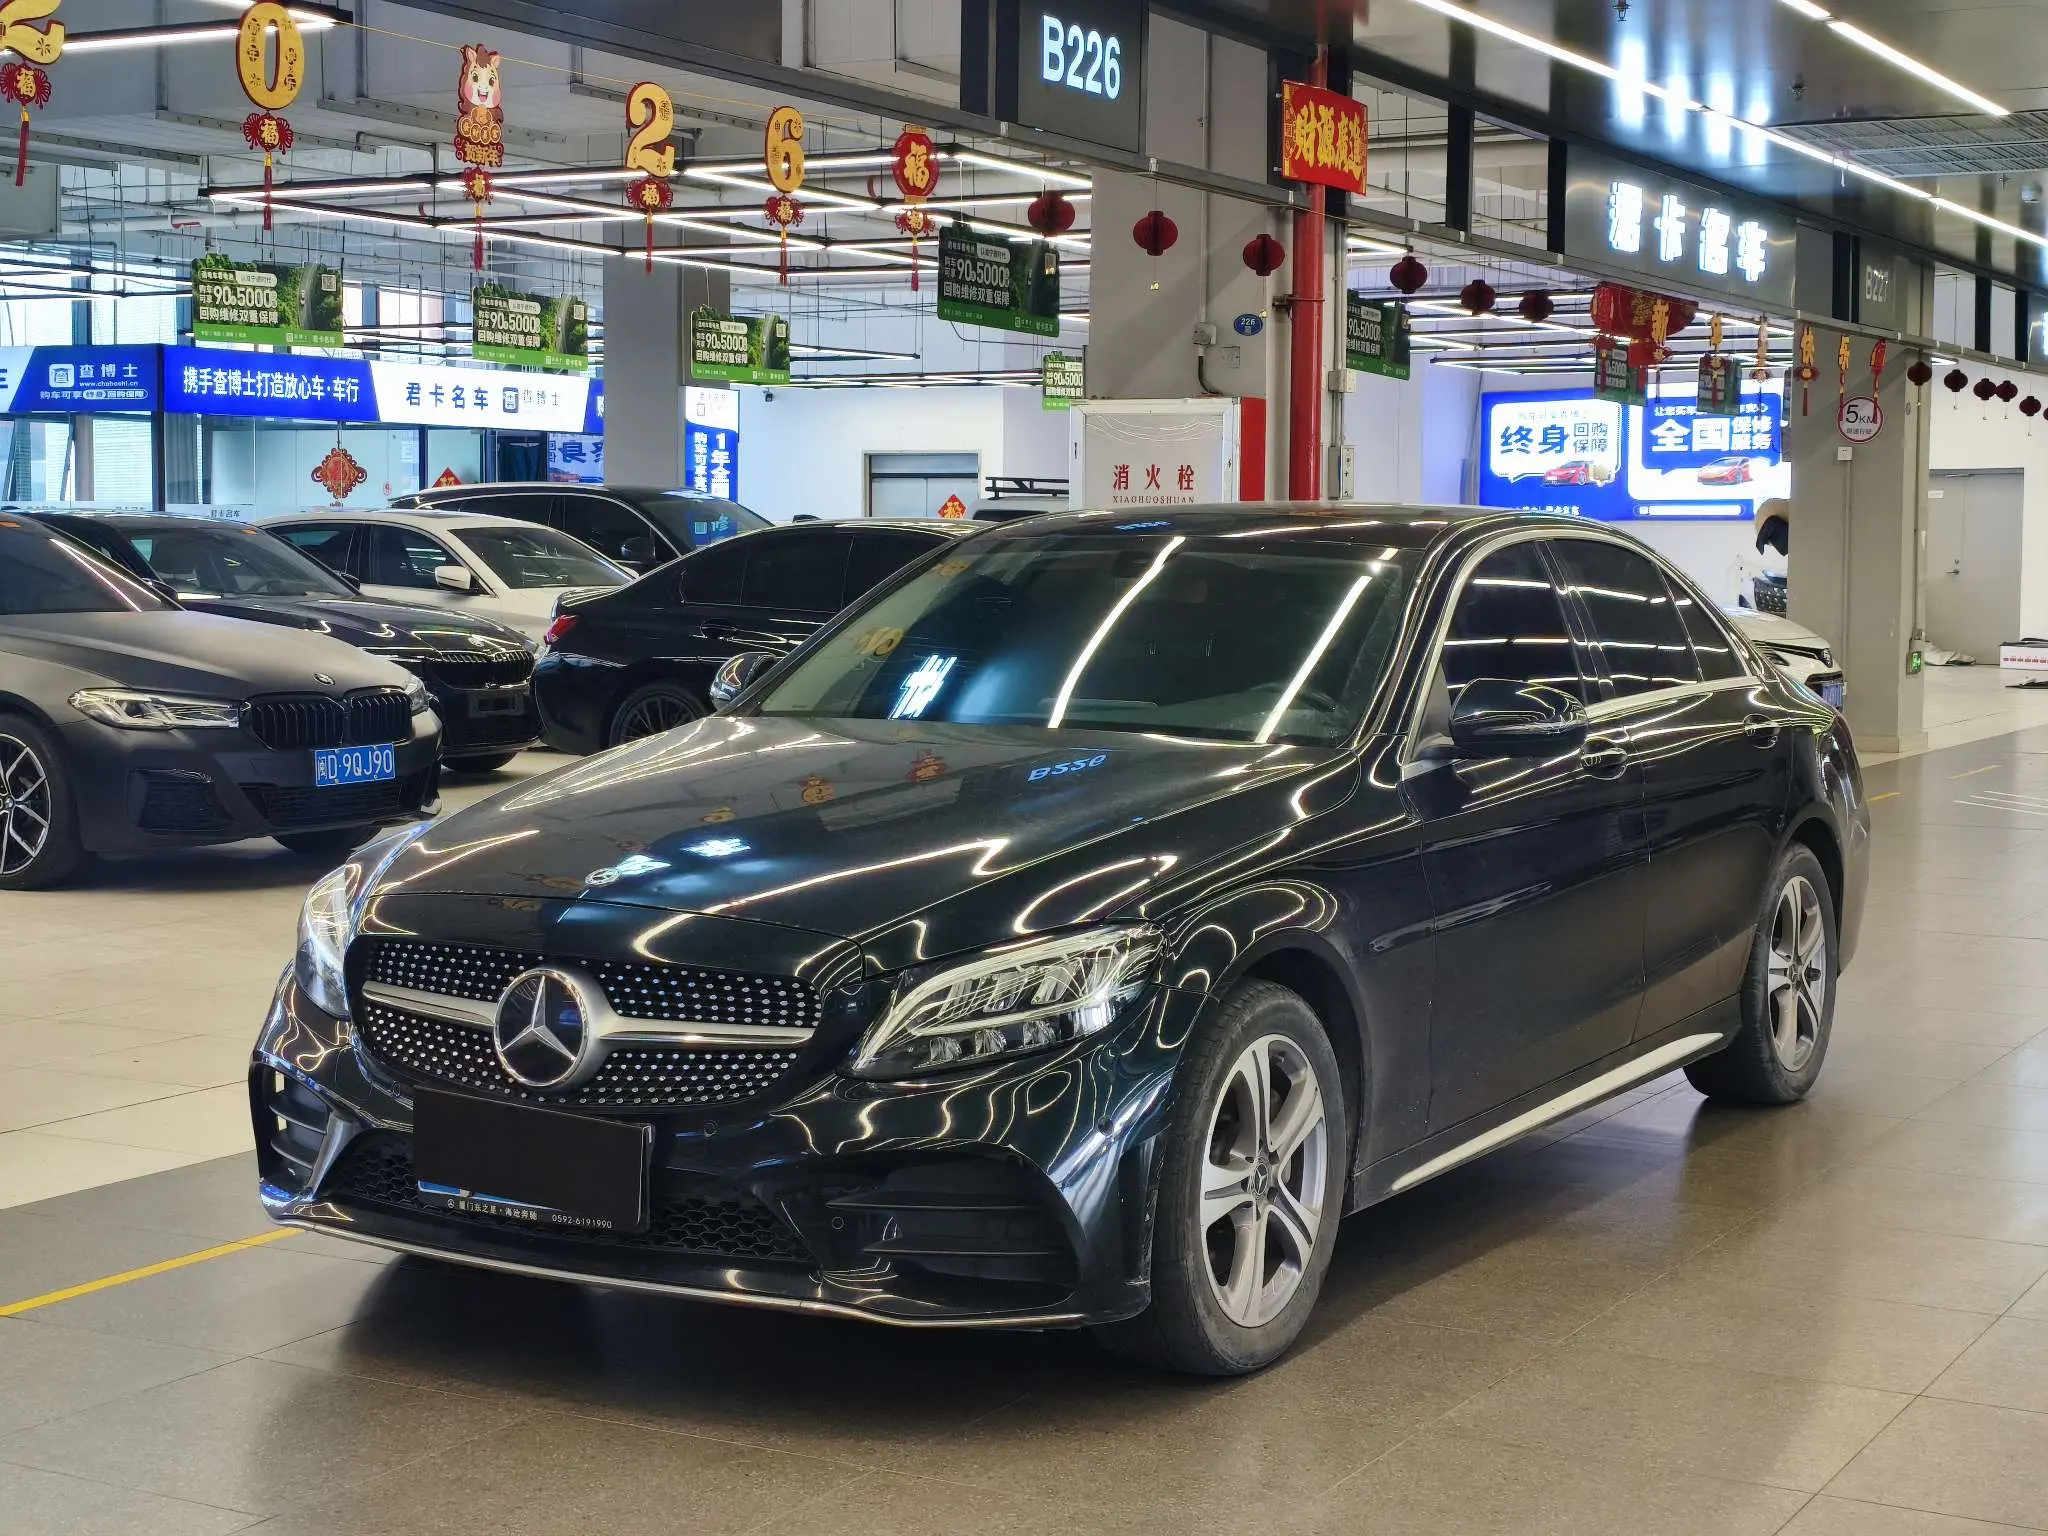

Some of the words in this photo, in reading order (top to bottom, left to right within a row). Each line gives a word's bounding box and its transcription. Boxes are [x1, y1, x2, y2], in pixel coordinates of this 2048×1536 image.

[1042, 14, 1121, 99] B226
[627, 82, 675, 177] 2
[765, 106, 804, 193] 6
[904, 141, 930, 189] 福
[199, 307, 278, 324] 回购维修双重保障
[79, 363, 138, 378] 查博士
[406, 382, 489, 411] 君卡名车
[1500, 424, 1570, 455] 终身
[1573, 422, 1609, 437] 回购
[1650, 418, 1730, 452] 全国
[1573, 438, 1609, 454] 保障
[1112, 463, 1196, 491] 消火栓
[1112, 495, 1195, 505] XIAOHUOSHUAN
[551, 1214, 612, 1229] 0592-6191990
